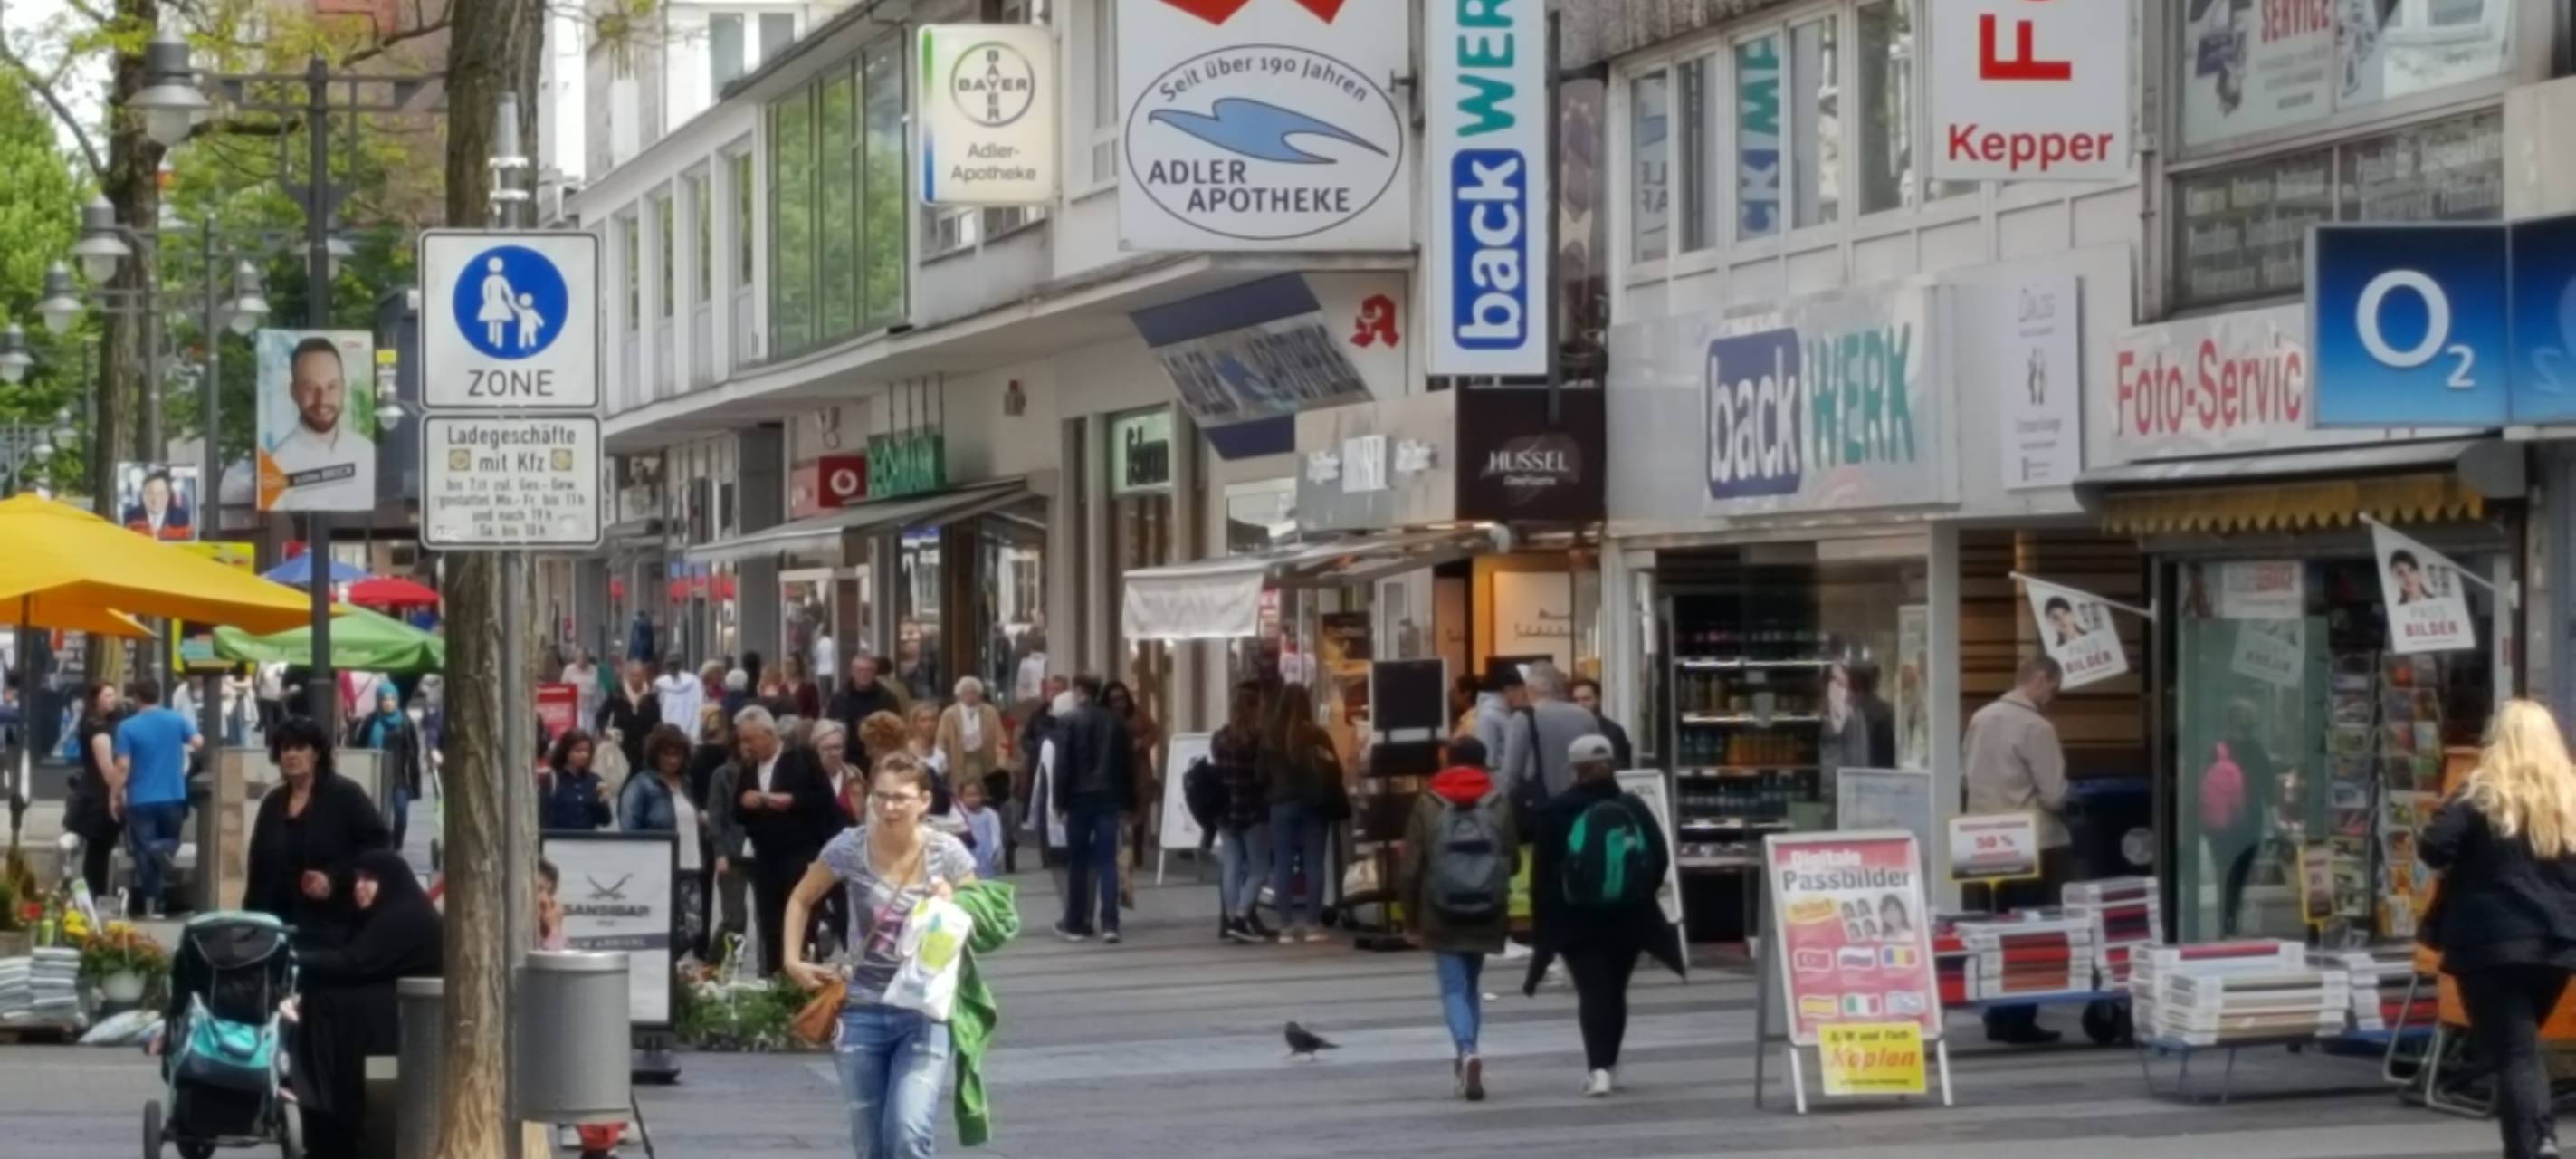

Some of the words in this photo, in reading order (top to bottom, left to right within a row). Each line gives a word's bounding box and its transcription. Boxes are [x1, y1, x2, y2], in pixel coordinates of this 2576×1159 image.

[1980, 0, 2072, 81] F
[958, 78, 1028, 91] BAYER
[1159, 68, 1200, 102] Seit
[1204, 56, 1252, 80] über
[1260, 57, 1296, 76] 190
[1301, 57, 1368, 103] Jahren
[968, 142, 1020, 158] Adler-
[1949, 123, 2113, 172] Kepper
[951, 165, 1036, 185] Apotheke
[1148, 159, 1247, 185] ADLER
[1187, 187, 1351, 213] APOTHEKE
[1456, 157, 1522, 340] back
[467, 369, 554, 397] ZONE
[1711, 345, 1798, 484] back
[1808, 322, 1916, 470] WERK
[447, 425, 576, 449] Ladegeschäfte
[479, 453, 507, 472] mit
[517, 453, 545, 472] Kfz
[1488, 450, 1569, 473] HUSSEL
[2404, 620, 2458, 637] BILDER
[2065, 650, 2113, 674] BILDER
[1790, 848, 1861, 868] Digitale
[1782, 867, 1910, 891] Passbilder
